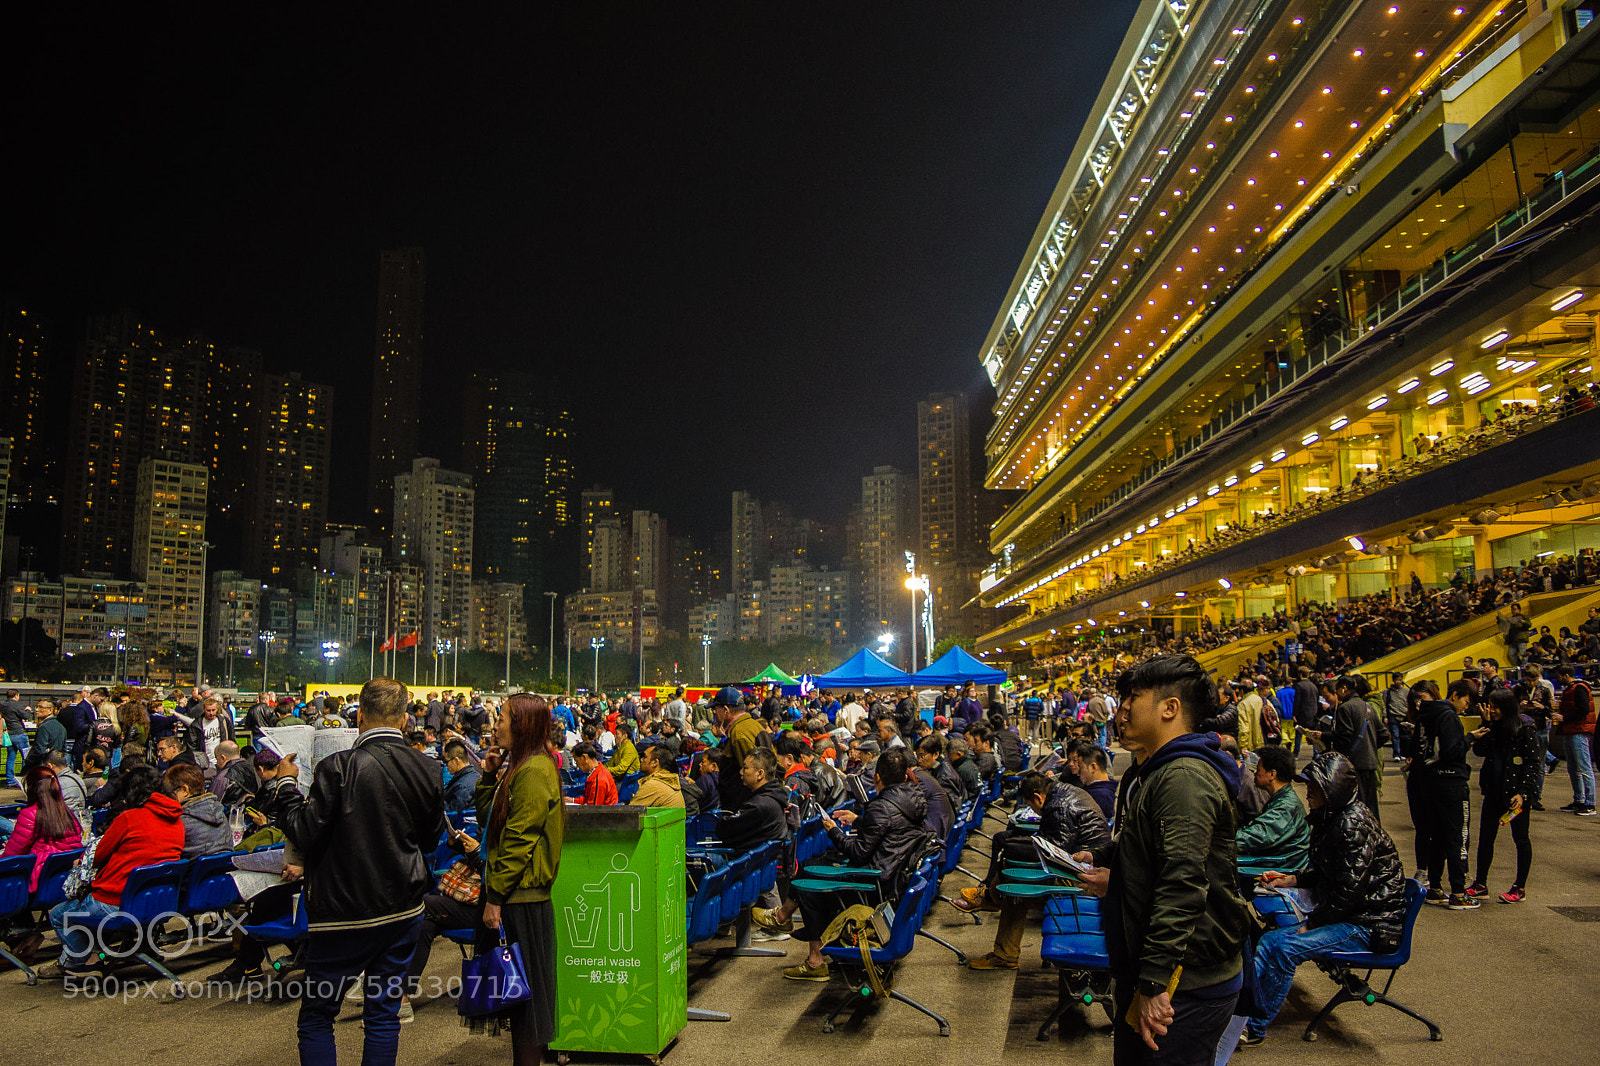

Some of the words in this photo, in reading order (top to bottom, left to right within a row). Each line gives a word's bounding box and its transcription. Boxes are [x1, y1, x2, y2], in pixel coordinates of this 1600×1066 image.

[564, 955, 606, 966] General
[609, 956, 641, 967] waste
[577, 969, 629, 984] 一般垃圾
